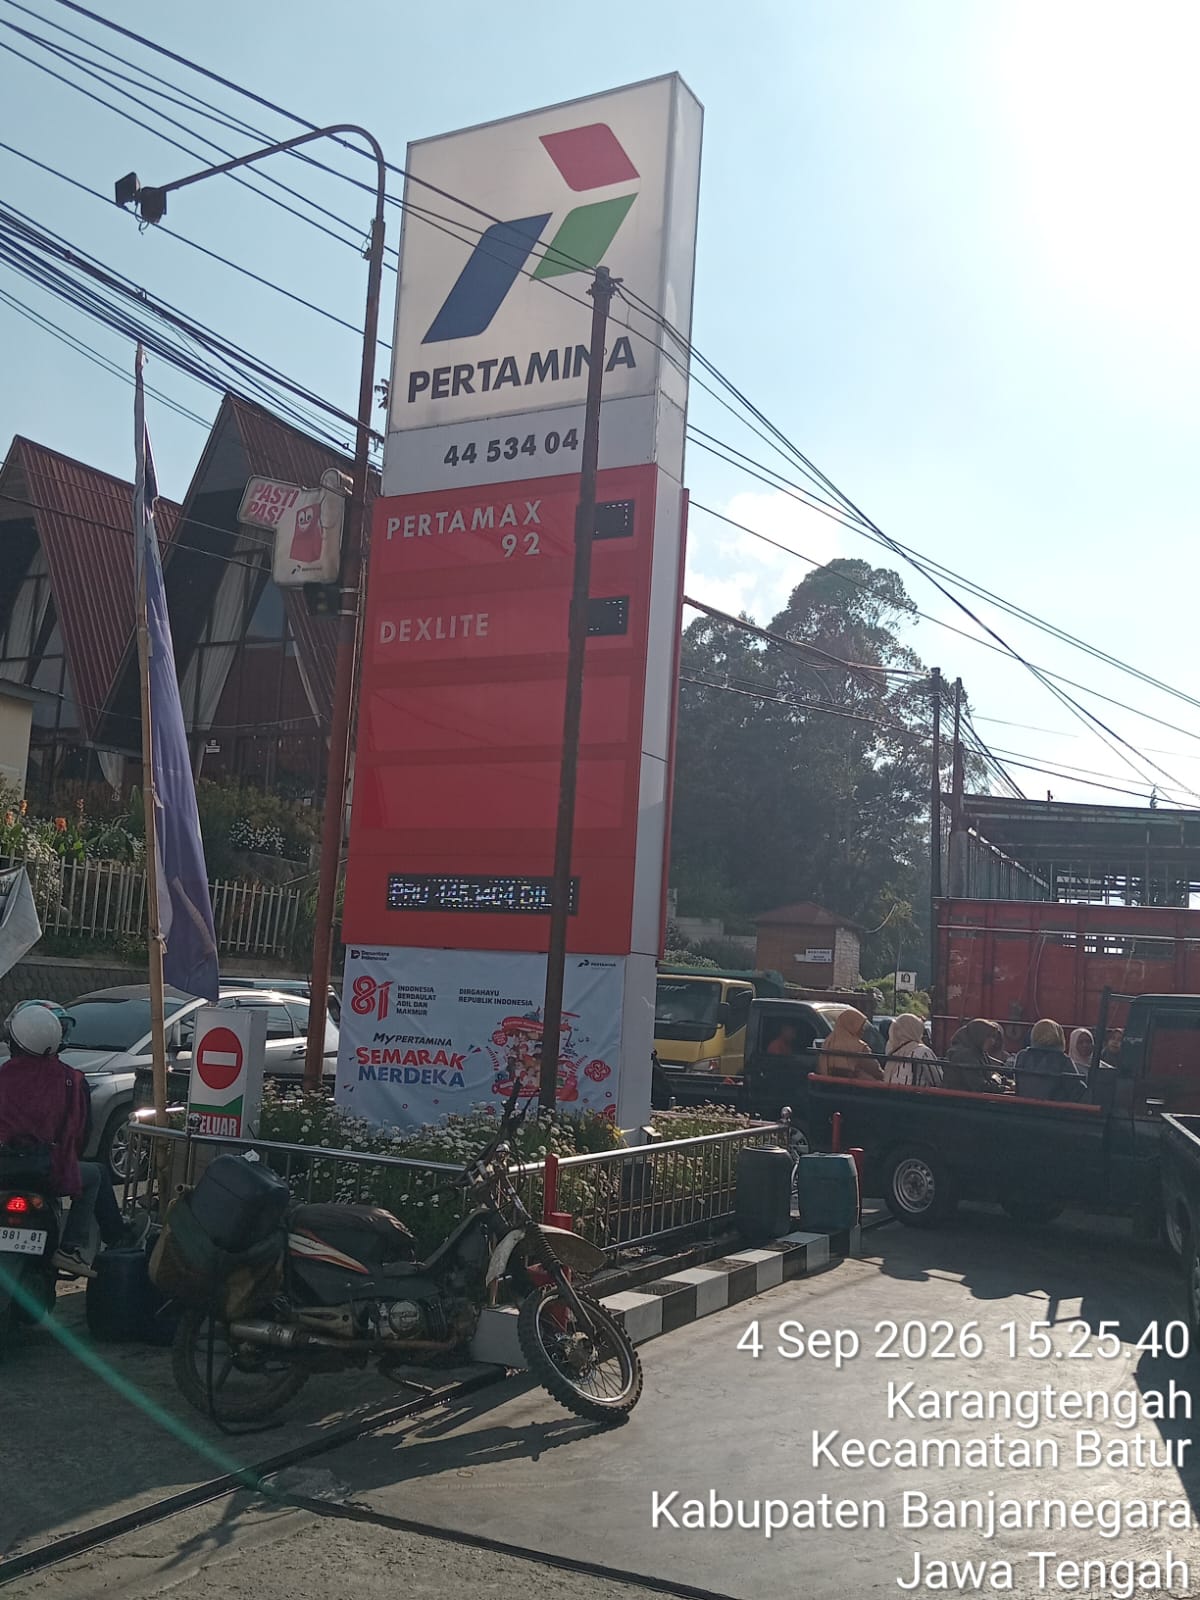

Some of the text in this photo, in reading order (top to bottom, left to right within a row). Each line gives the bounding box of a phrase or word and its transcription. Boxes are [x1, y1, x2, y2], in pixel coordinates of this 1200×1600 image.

[443, 428, 579, 467] 44 534 04
[251, 484, 300, 508] PASTI
[386, 500, 542, 540] PERTAMAX
[502, 532, 541, 558] 92
[380, 613, 489, 644] DEXLITE
[351, 975, 394, 1022] 81
[397, 985, 435, 993] INDONESIA
[397, 993, 437, 1001] BERDAULAT
[459, 988, 500, 997] DIRGAHAYU
[396, 1008, 428, 1016] MAKMUR
[458, 996, 533, 1007] REPUBLIK INDONESIA
[356, 1046, 467, 1071] SEMARAK
[358, 1065, 465, 1088] MERDEKA
[198, 1114, 238, 1137] ELUAR
